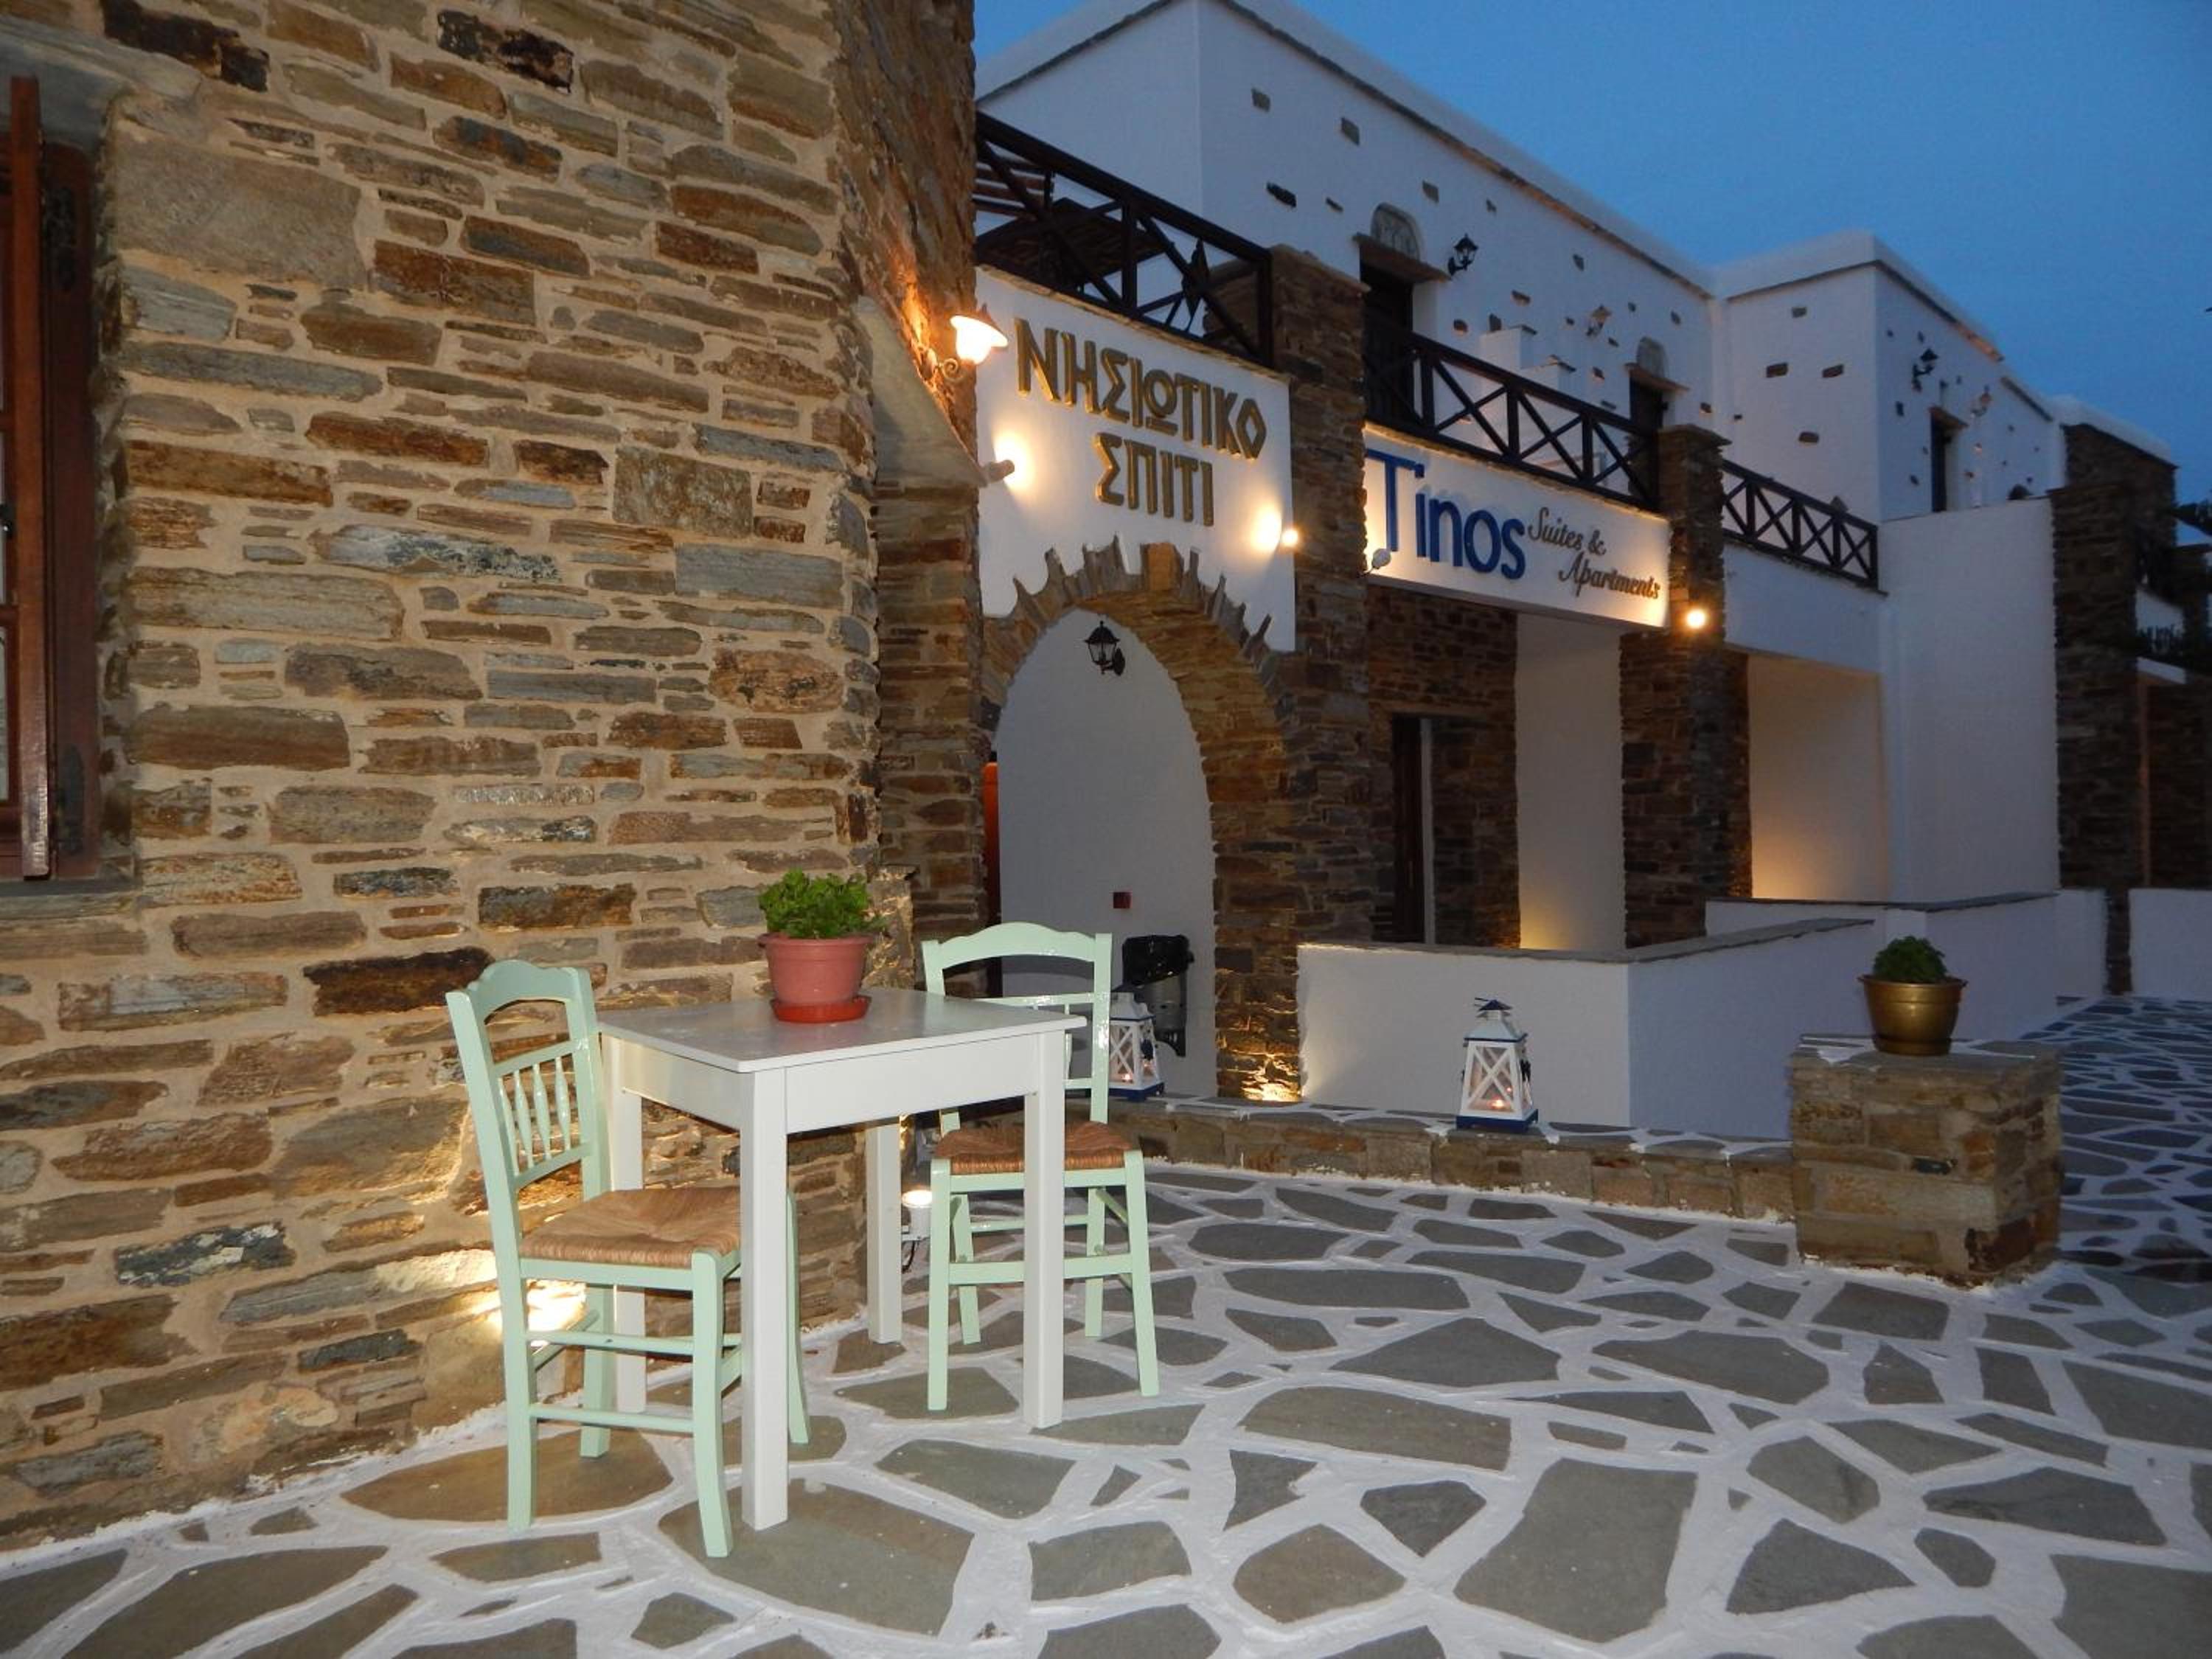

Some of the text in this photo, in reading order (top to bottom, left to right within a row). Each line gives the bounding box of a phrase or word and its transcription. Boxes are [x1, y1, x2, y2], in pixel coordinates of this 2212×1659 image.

[1015, 317, 1267, 459] ΝΗΣΙΩΤΙΚΟ
[1094, 432, 1214, 526] ΣΠΙΤΙ
[1366, 448, 1526, 580] Tinos
[1528, 507, 1607, 556] Suites &
[1558, 553, 1660, 599] Apartments
